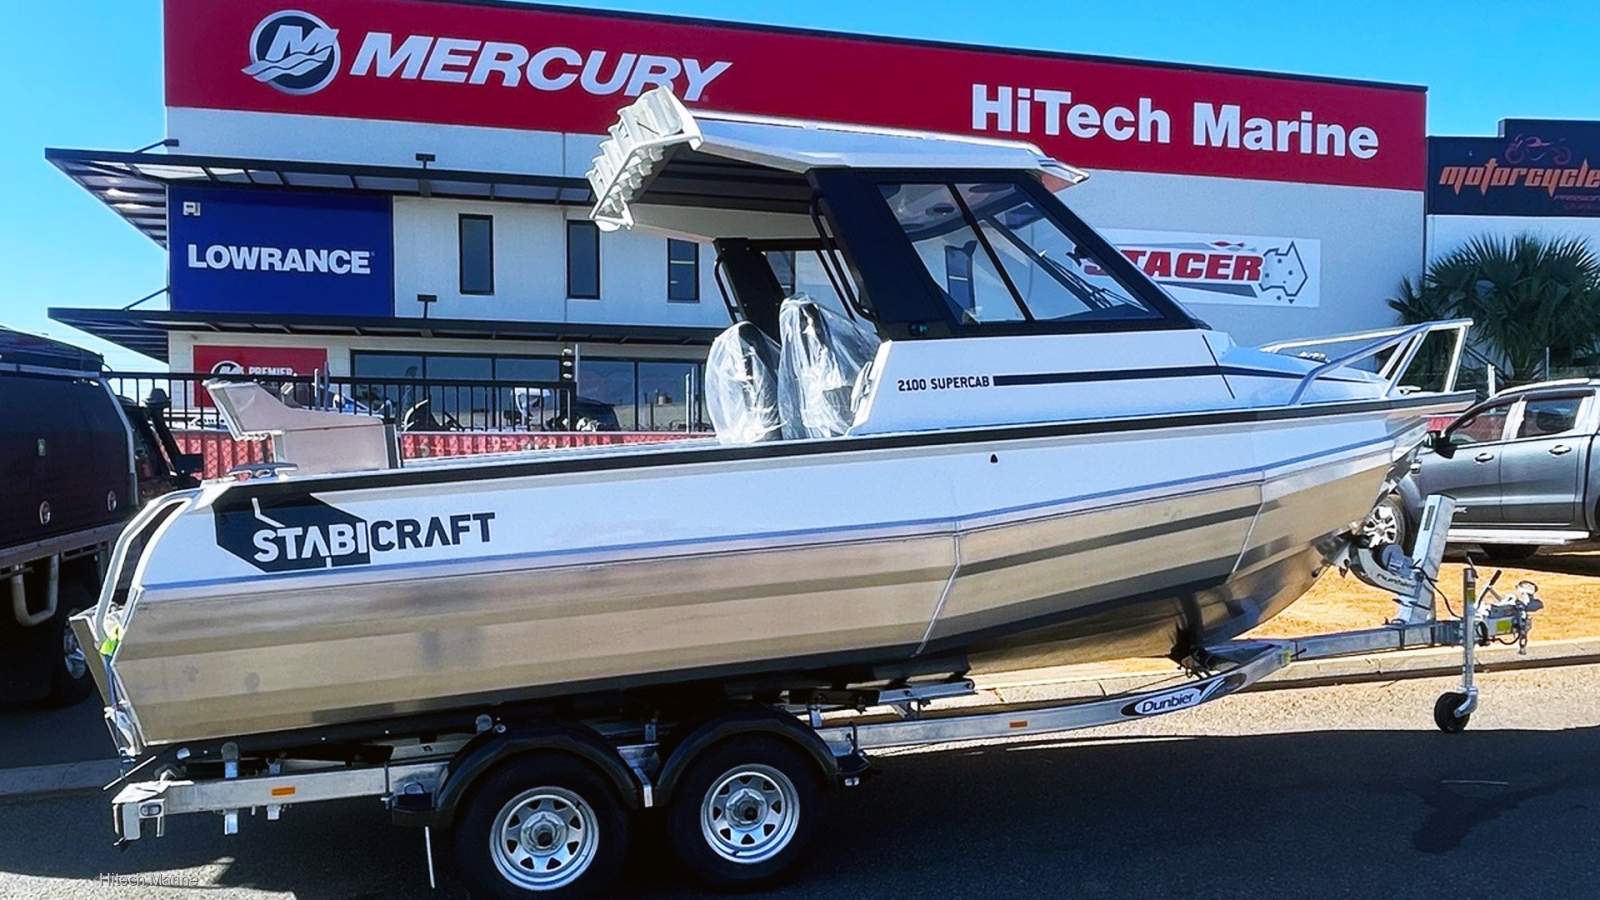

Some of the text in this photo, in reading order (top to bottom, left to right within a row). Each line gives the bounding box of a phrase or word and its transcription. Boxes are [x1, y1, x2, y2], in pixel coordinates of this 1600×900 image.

[350, 32, 733, 101] MERCURY
[971, 83, 1379, 159] HiTech Marine
[187, 244, 371, 275] LOWRANCE
[248, 366, 294, 376] PREMIER
[897, 375, 990, 392] 2100 SUPERCAB
[253, 512, 496, 562] STABICRAFT
[1141, 692, 1194, 713] Dunbier
